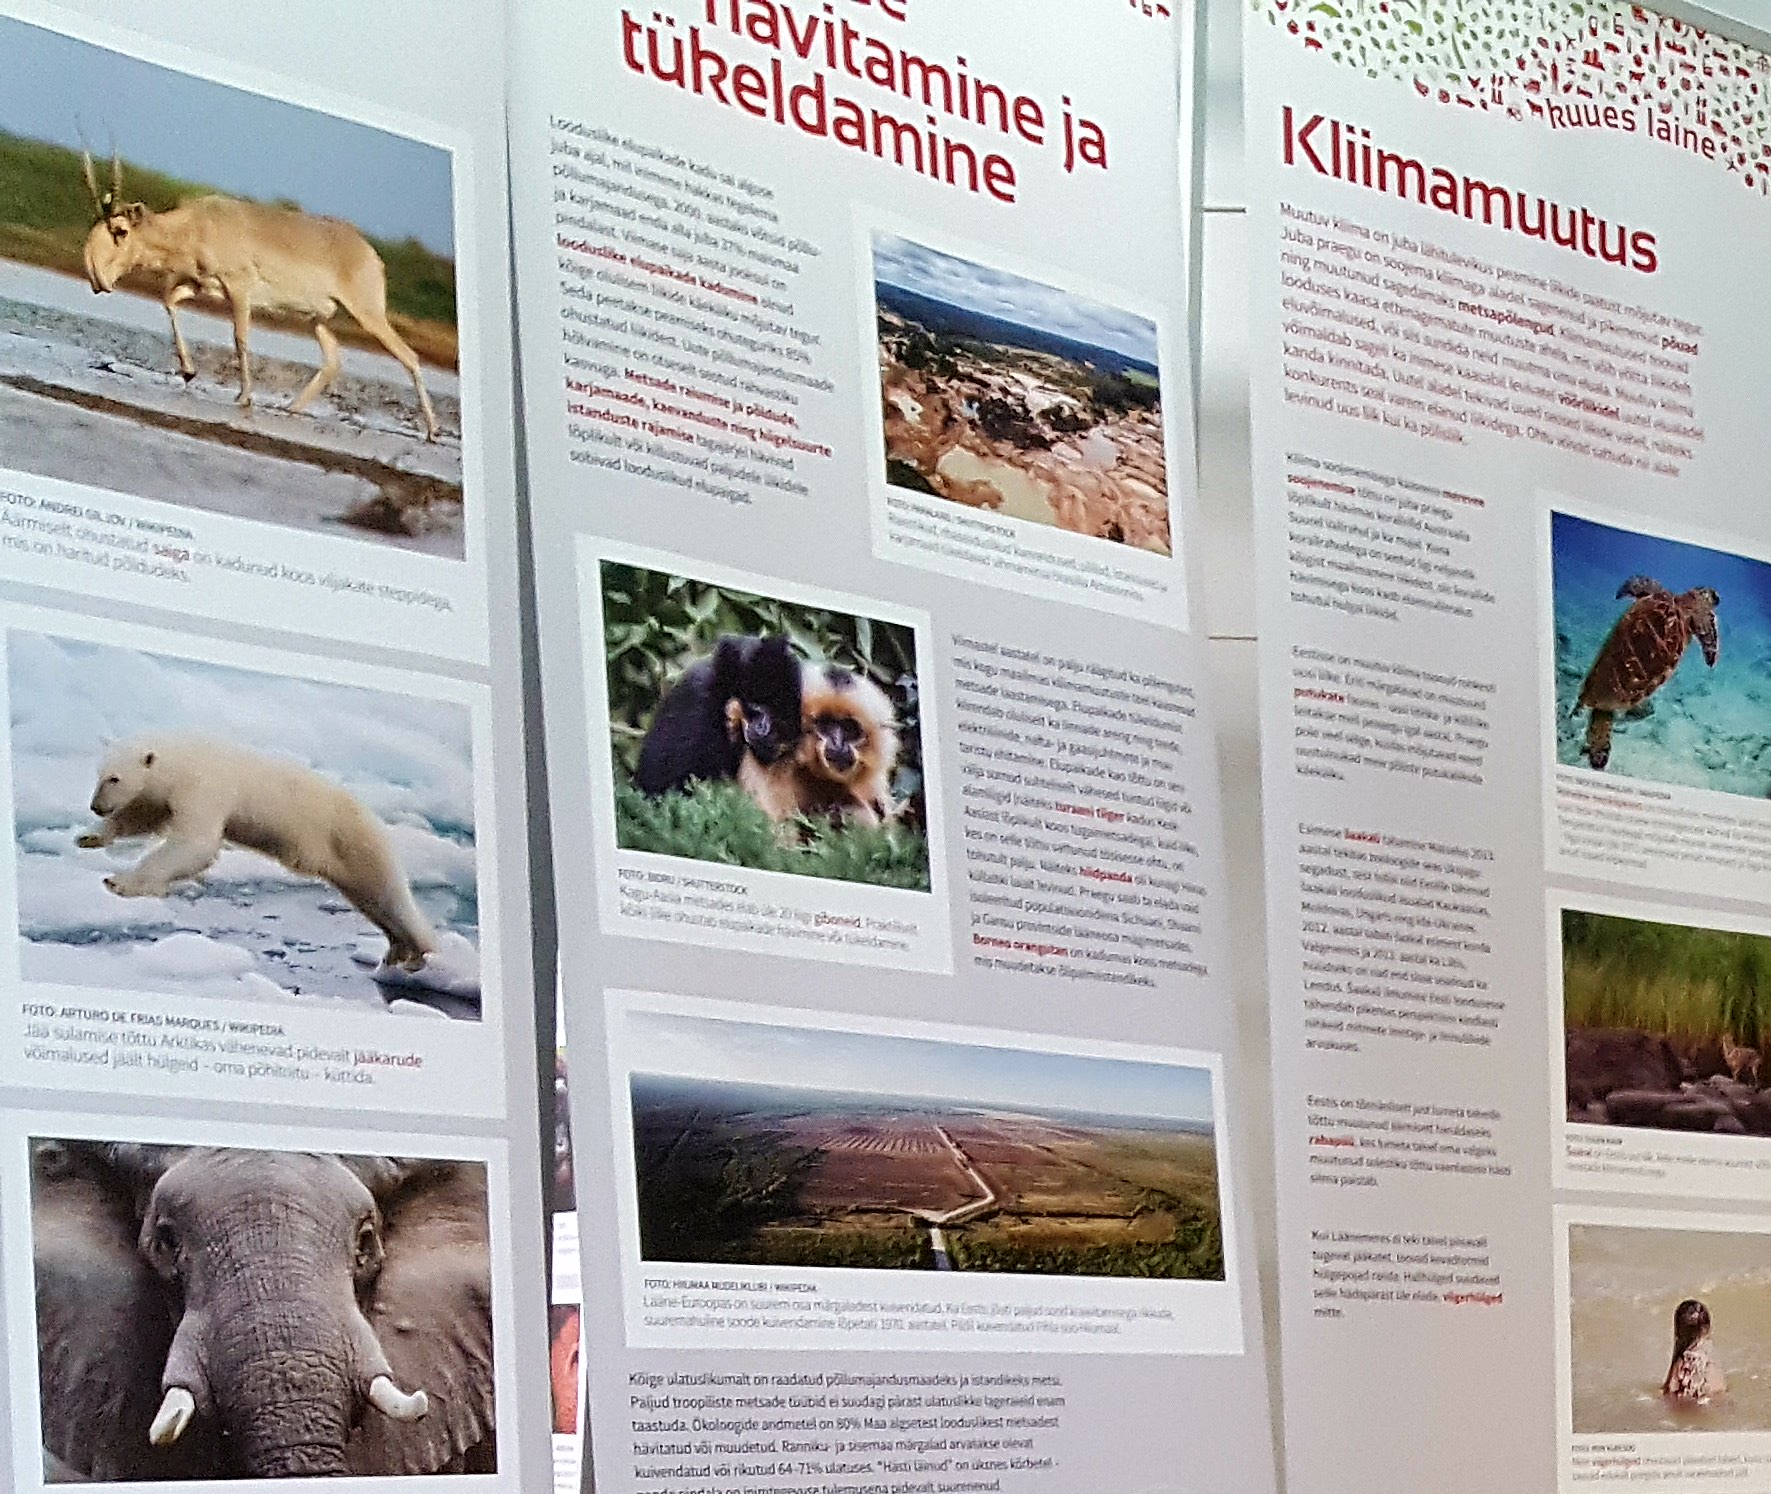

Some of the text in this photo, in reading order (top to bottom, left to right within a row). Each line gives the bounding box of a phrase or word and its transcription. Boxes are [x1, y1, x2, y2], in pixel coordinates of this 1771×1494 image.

[620, 9, 1017, 204] tükeldamine
[1061, 95, 1108, 173] ja
[1547, 98, 1716, 161] kuues laine
[1282, 105, 1658, 274] Kliimamuutus
